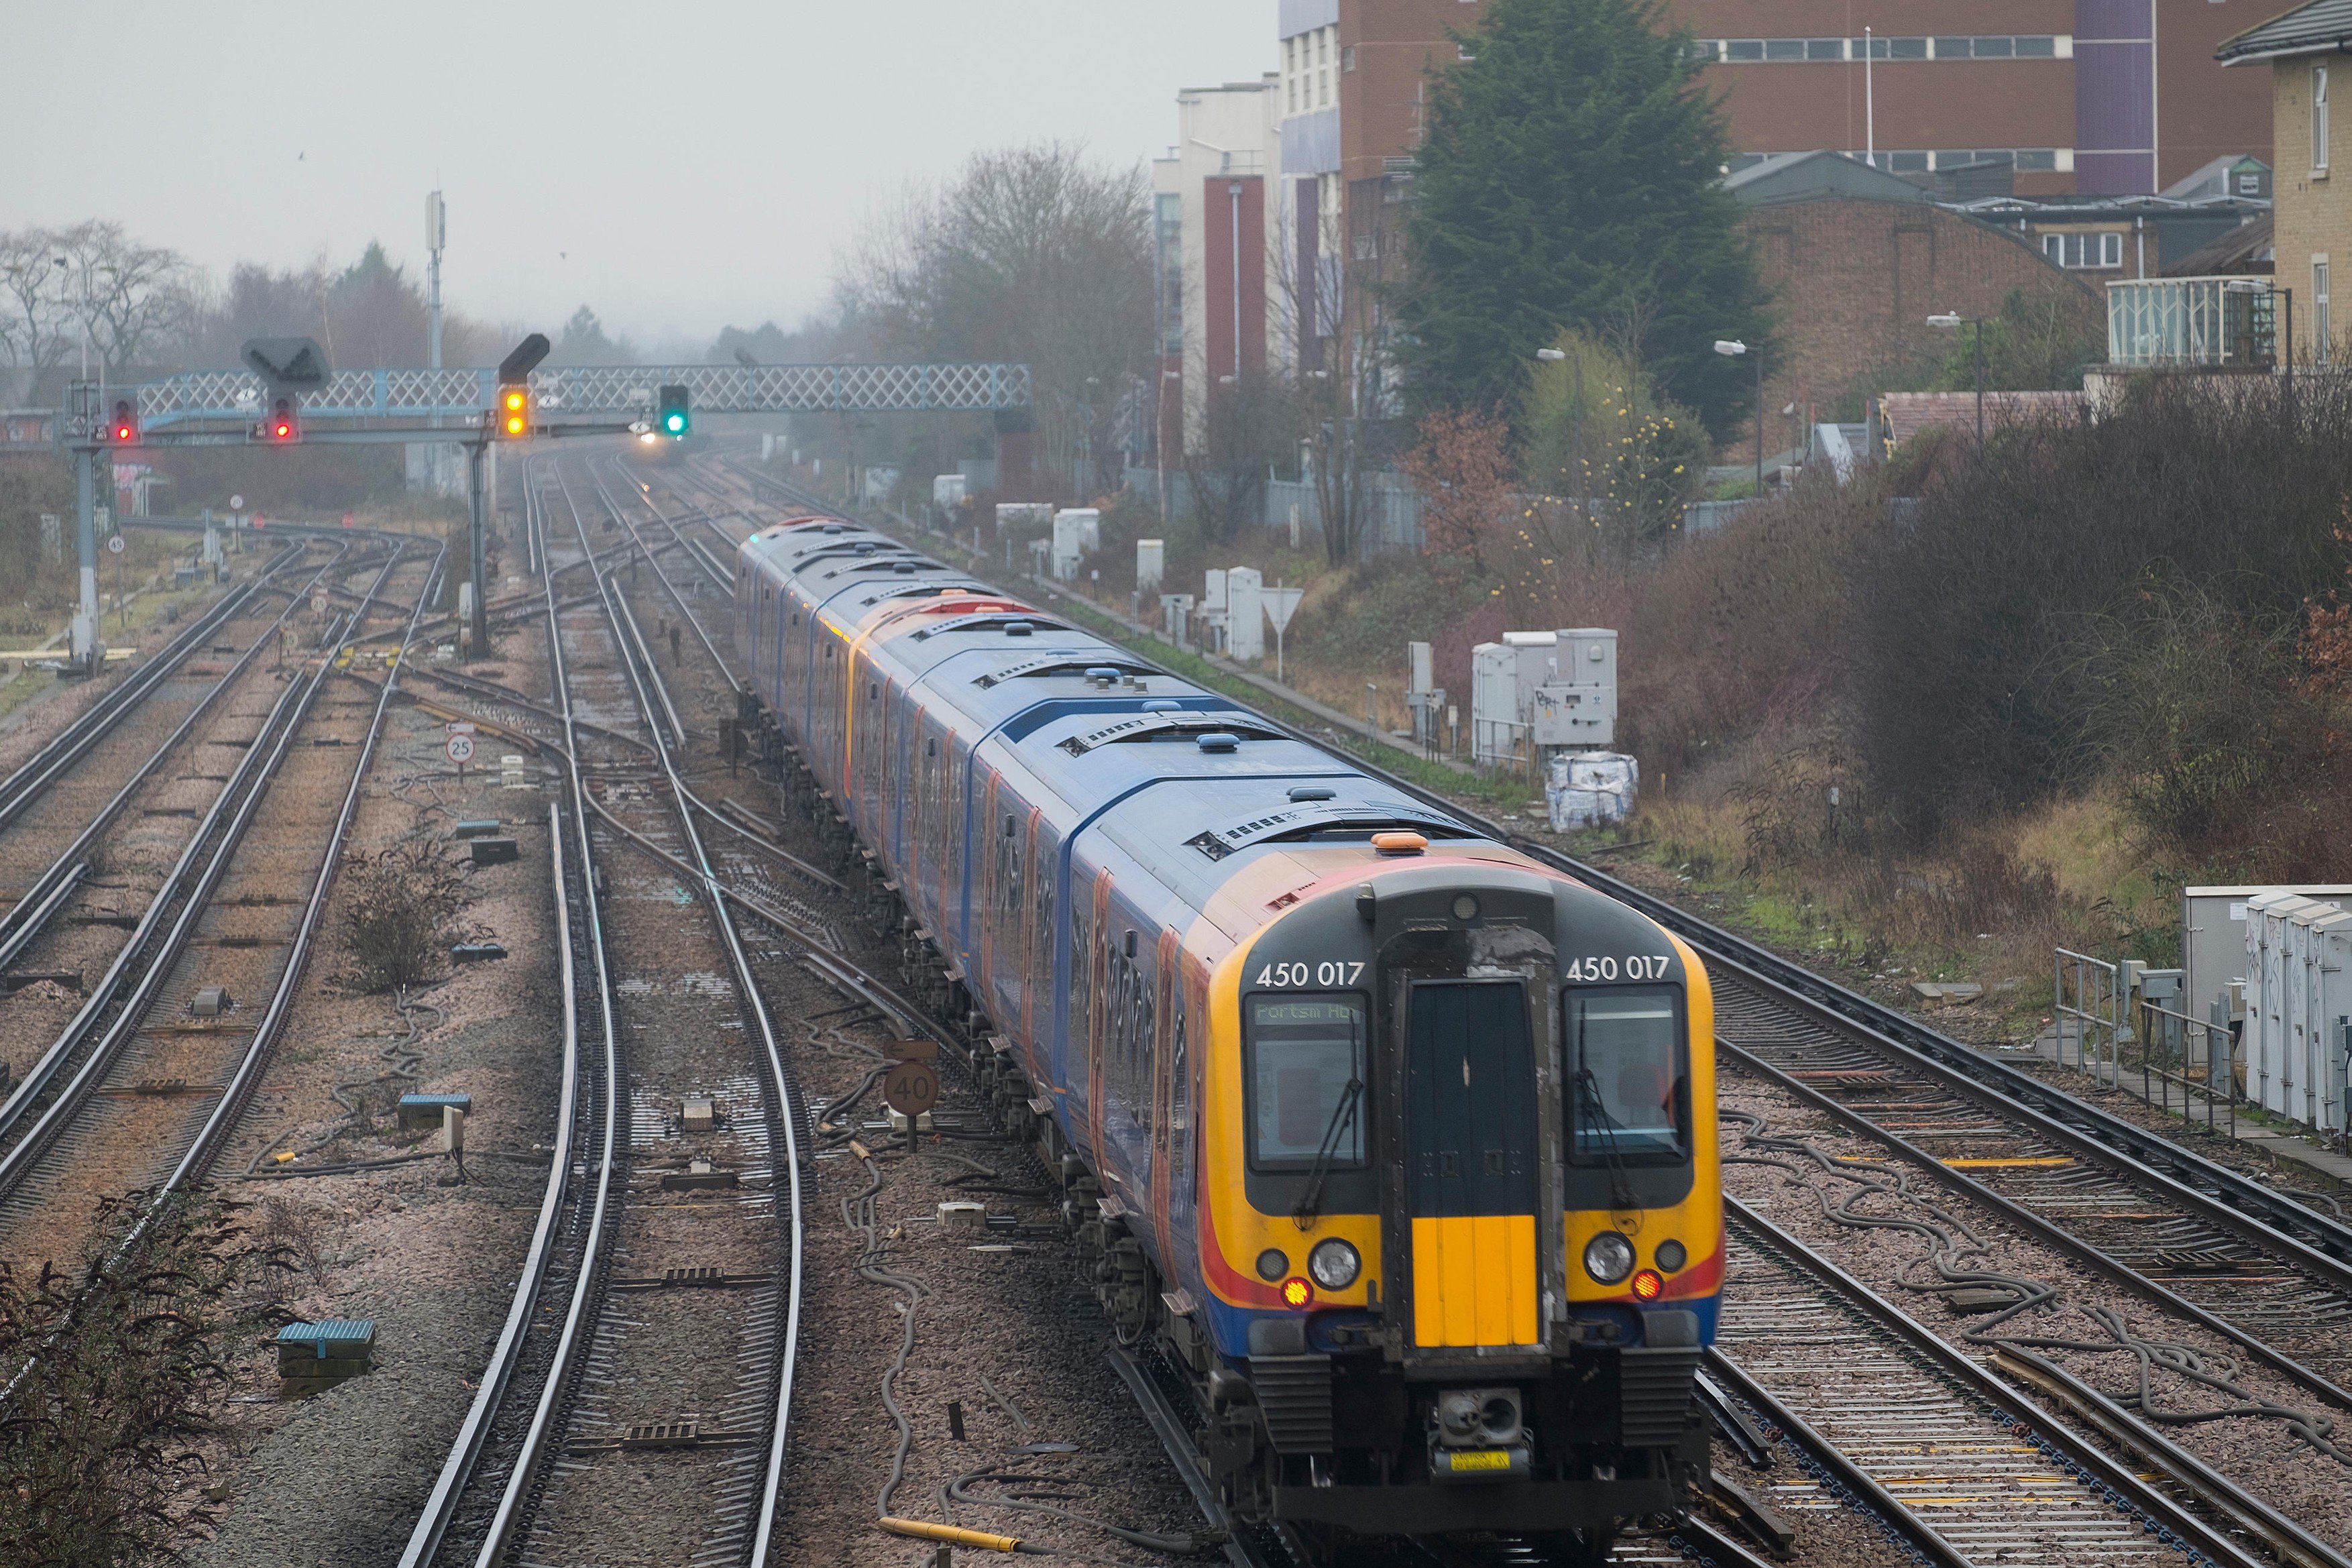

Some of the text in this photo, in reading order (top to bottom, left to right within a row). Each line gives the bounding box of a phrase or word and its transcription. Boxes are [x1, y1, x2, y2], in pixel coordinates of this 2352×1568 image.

[111, 539, 122, 550] 45
[452, 741, 469, 755] 25
[1255, 961, 1366, 988] 450 017
[1565, 955, 1671, 982] 450 017
[1256, 1004, 1321, 1019] Portsm
[894, 1076, 929, 1101] 40
